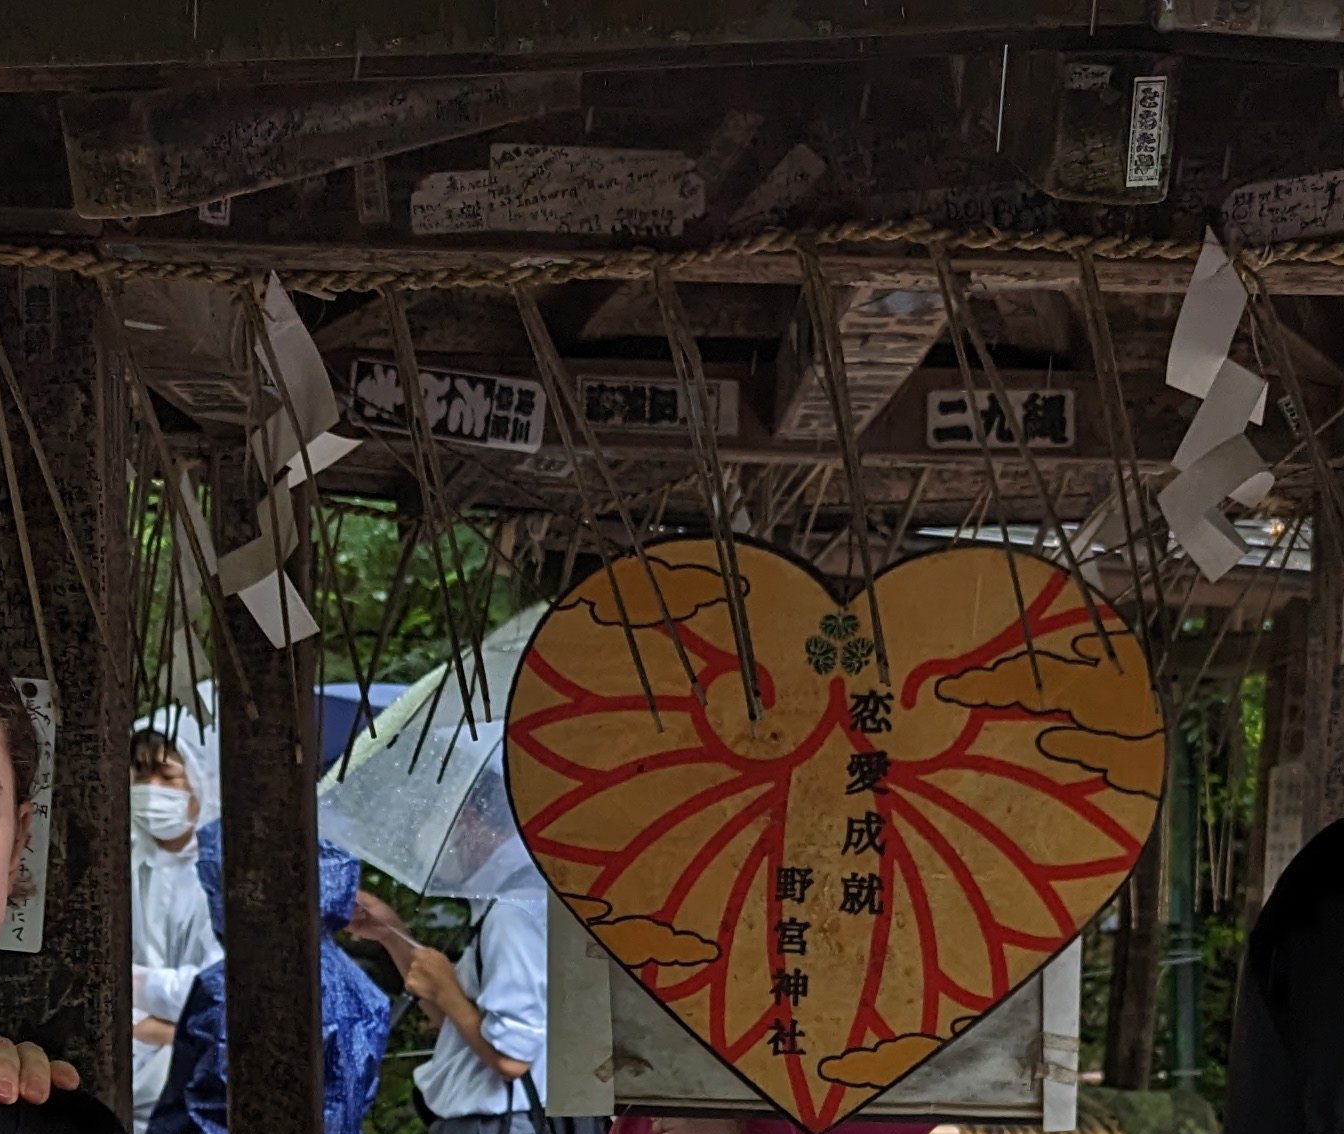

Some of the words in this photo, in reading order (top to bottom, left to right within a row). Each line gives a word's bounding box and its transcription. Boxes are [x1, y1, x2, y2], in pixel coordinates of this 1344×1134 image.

[840, 689, 895, 918] 恋愛成就
[766, 866, 814, 1057] 野宮神社
